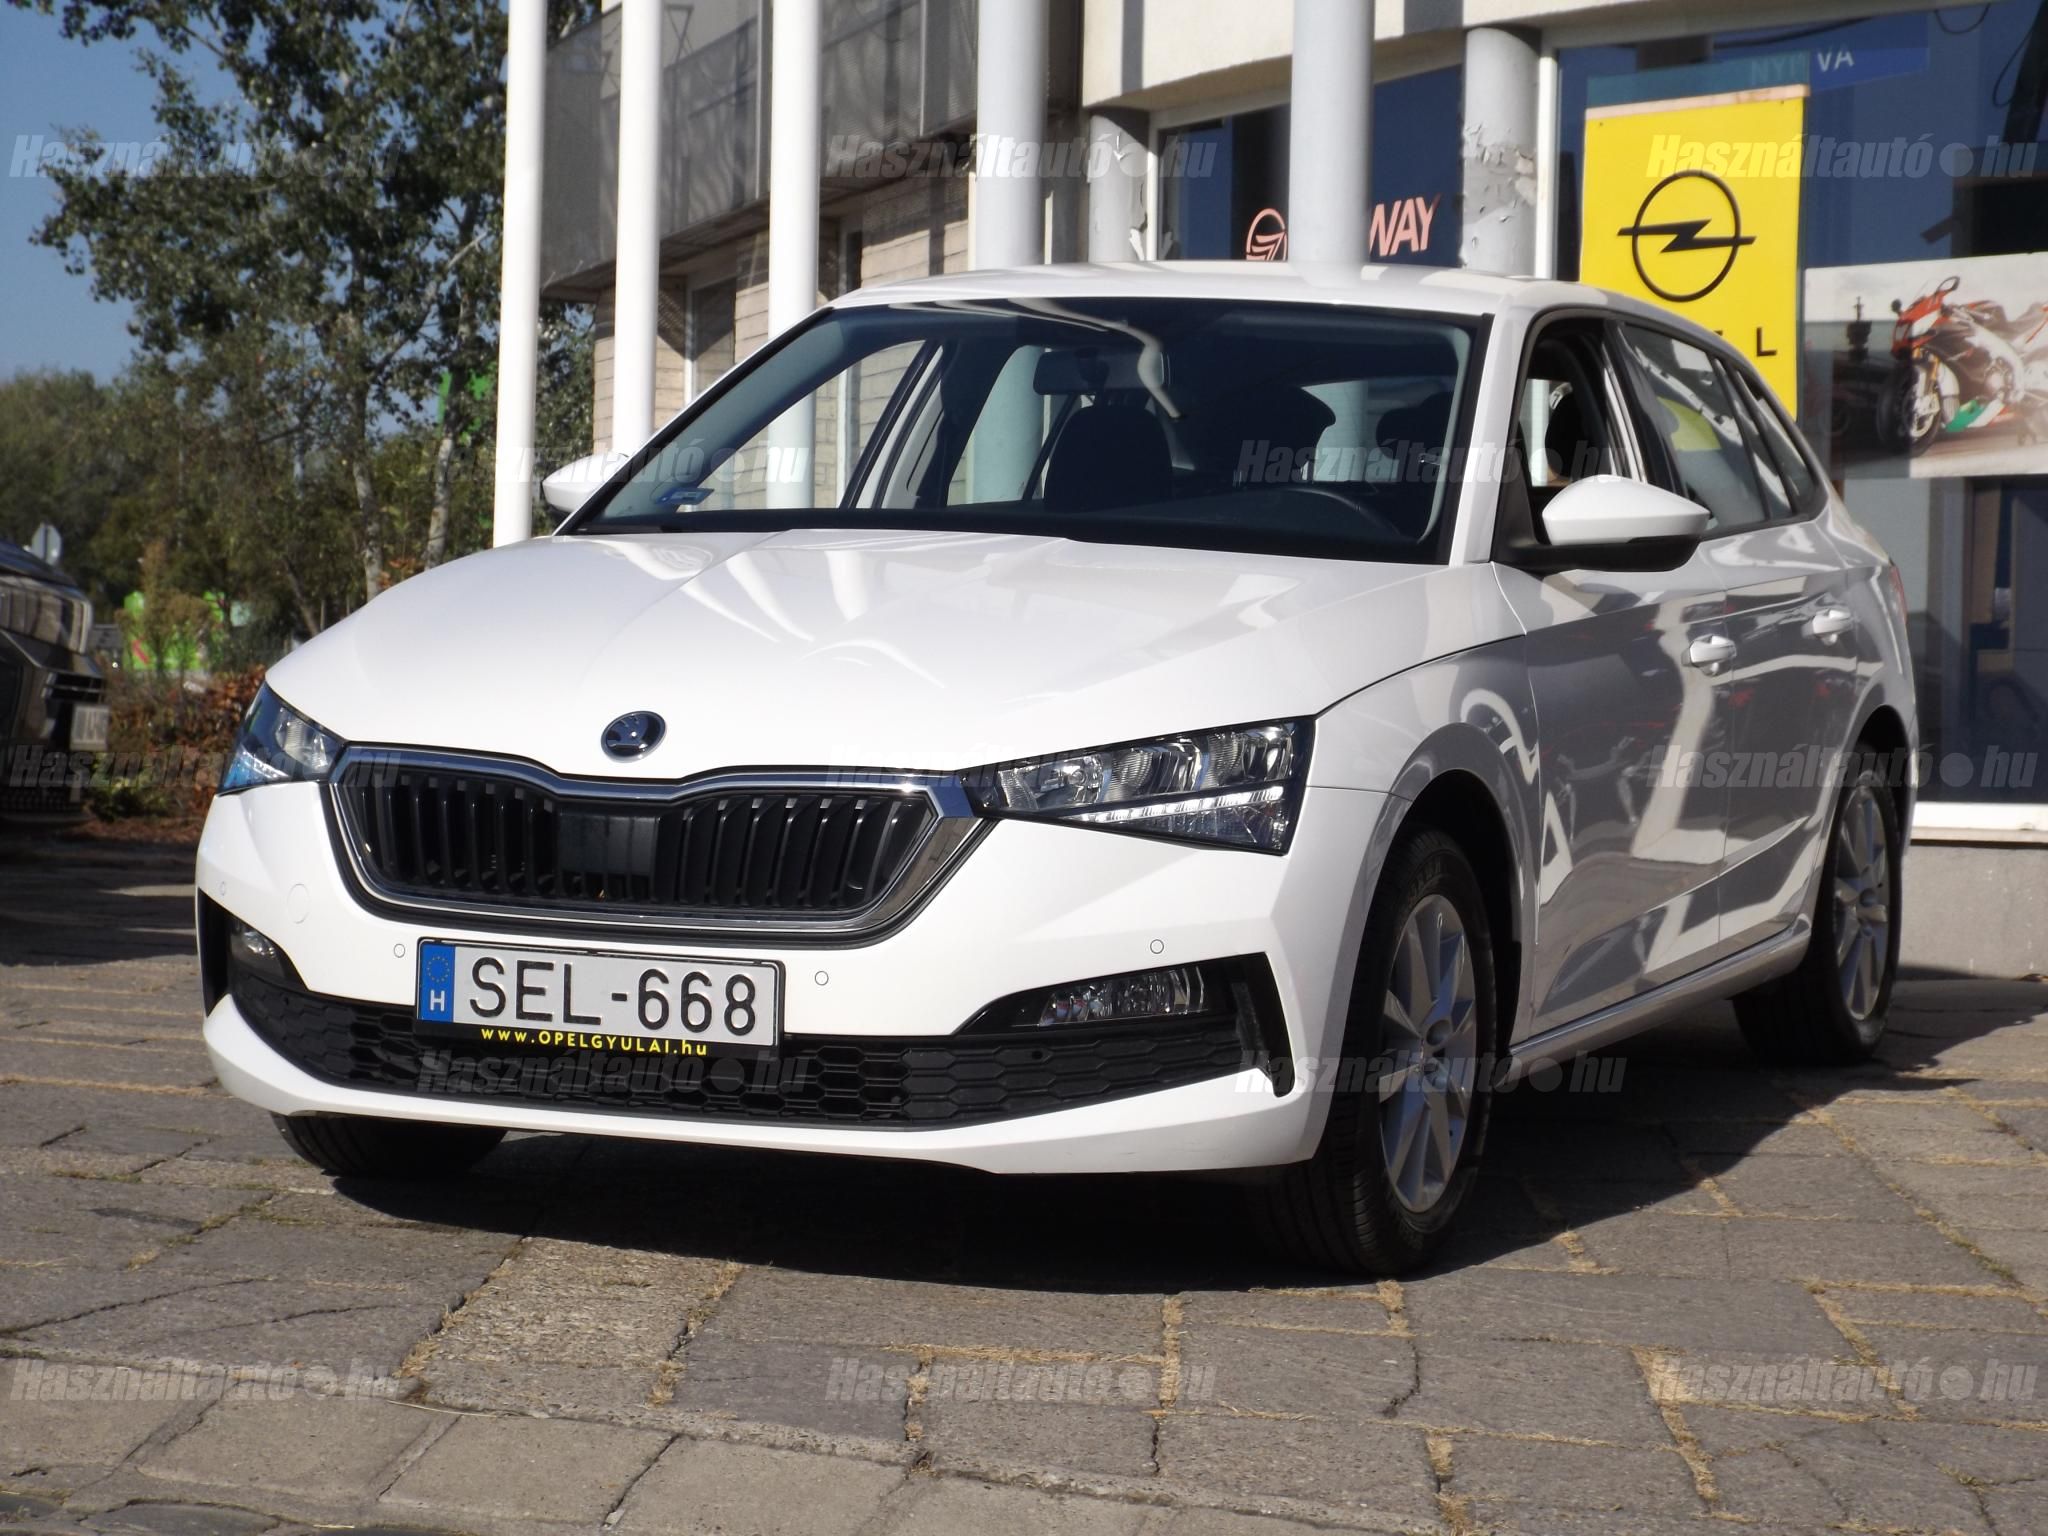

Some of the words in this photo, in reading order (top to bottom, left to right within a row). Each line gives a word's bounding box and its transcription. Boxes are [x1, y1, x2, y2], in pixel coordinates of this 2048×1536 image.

[430, 990, 445, 1012] H
[469, 956, 757, 1037] SEL-668
[481, 1028, 707, 1056] www.OPELGYULAI.hu
